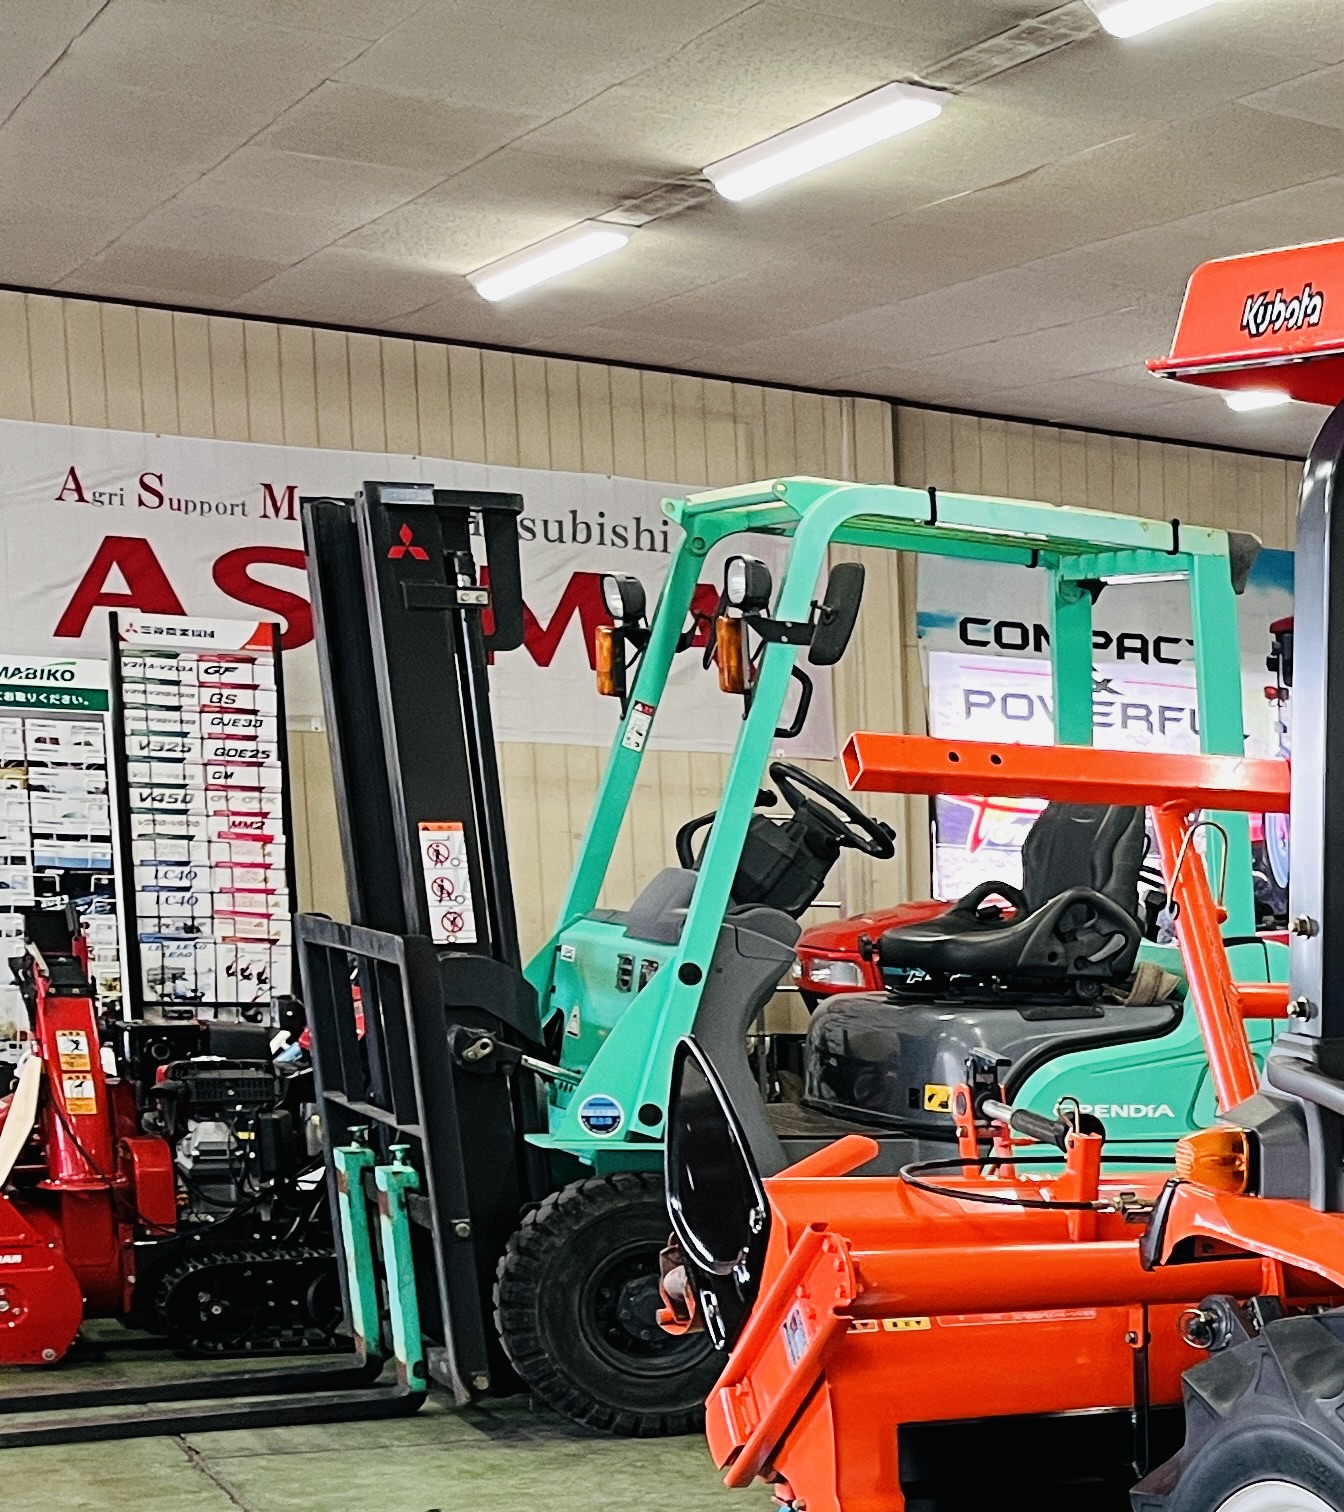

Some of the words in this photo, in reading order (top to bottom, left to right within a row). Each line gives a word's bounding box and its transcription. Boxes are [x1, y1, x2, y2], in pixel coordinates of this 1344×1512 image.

[1240, 282, 1324, 339] Kubota
[55, 466, 126, 508] Agri
[137, 472, 249, 518] Support
[0, 691, 89, 706] お取りください。
